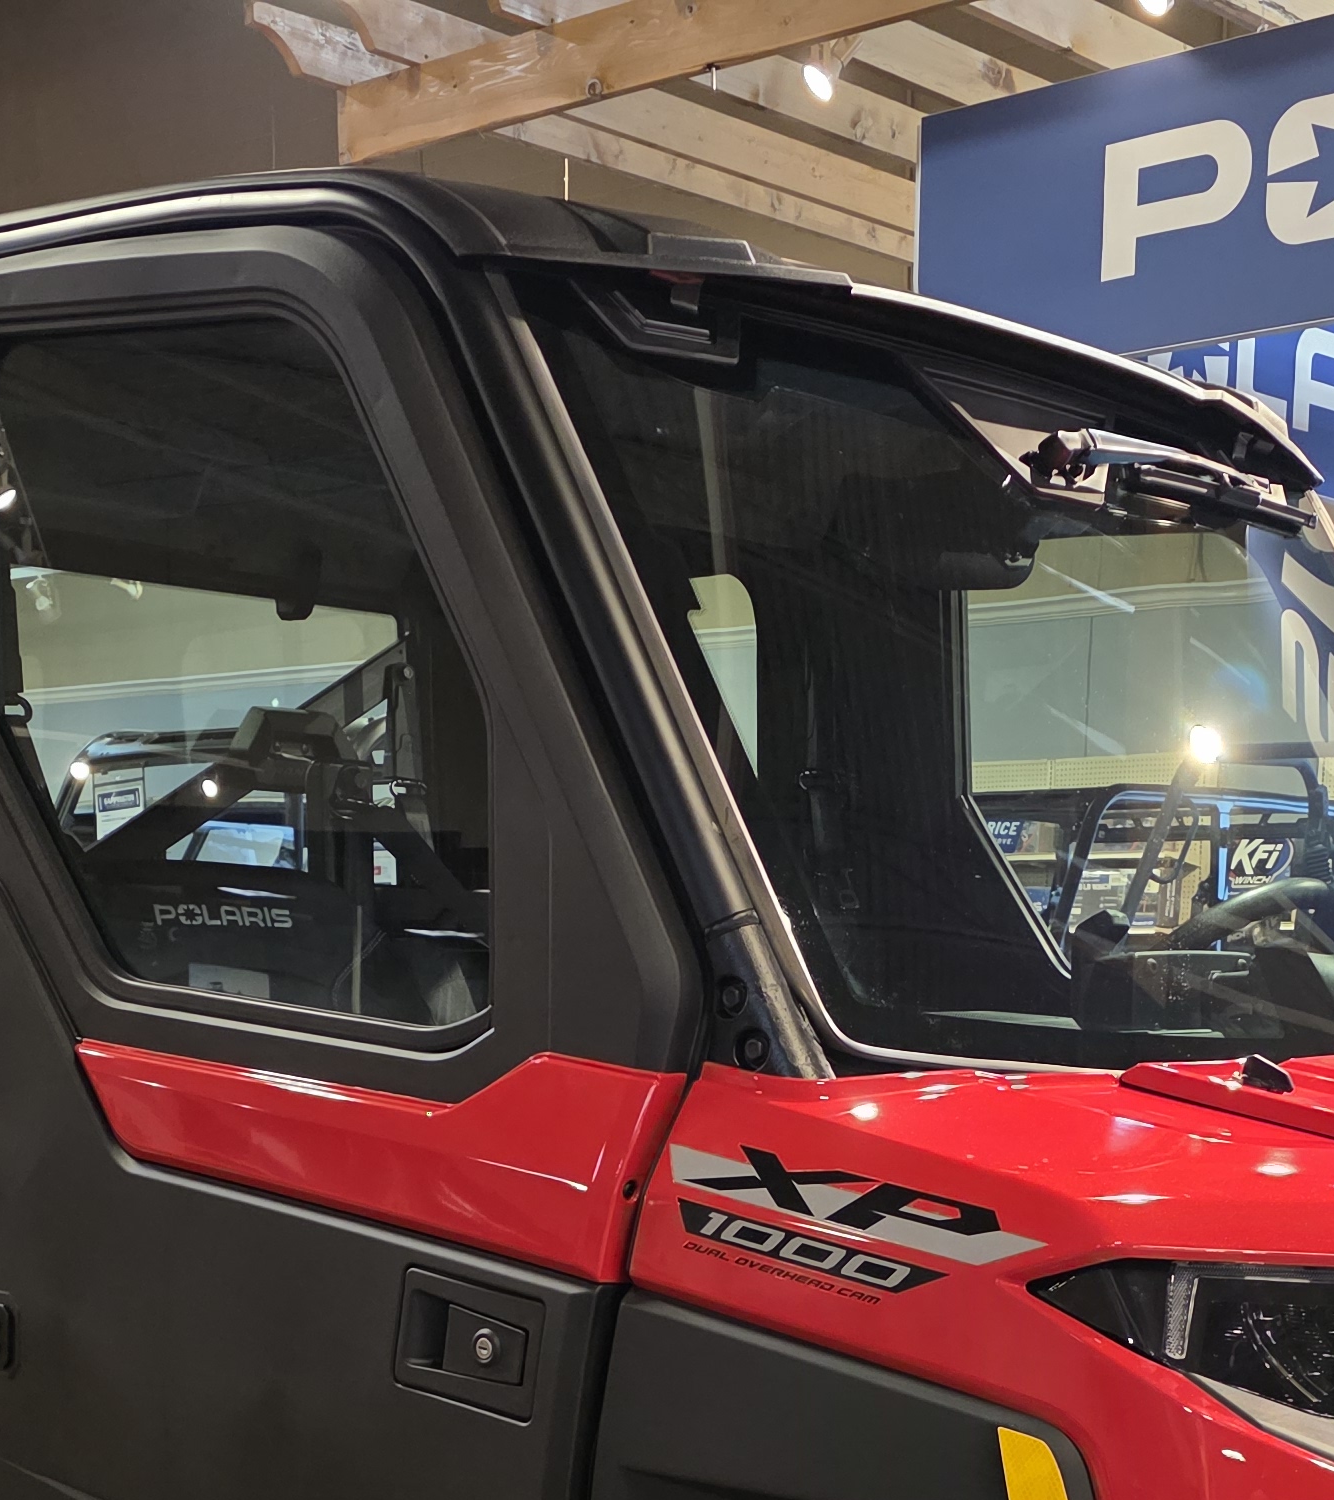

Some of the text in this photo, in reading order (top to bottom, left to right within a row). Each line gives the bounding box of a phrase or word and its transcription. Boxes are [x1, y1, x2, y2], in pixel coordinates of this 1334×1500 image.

[987, 821, 1021, 836] RICE
[152, 903, 294, 929] POLARIS
[682, 1143, 1002, 1236] XP
[682, 1240, 882, 1305] DUAL OVERHEAD CAM
[698, 1211, 912, 1288] 1000
